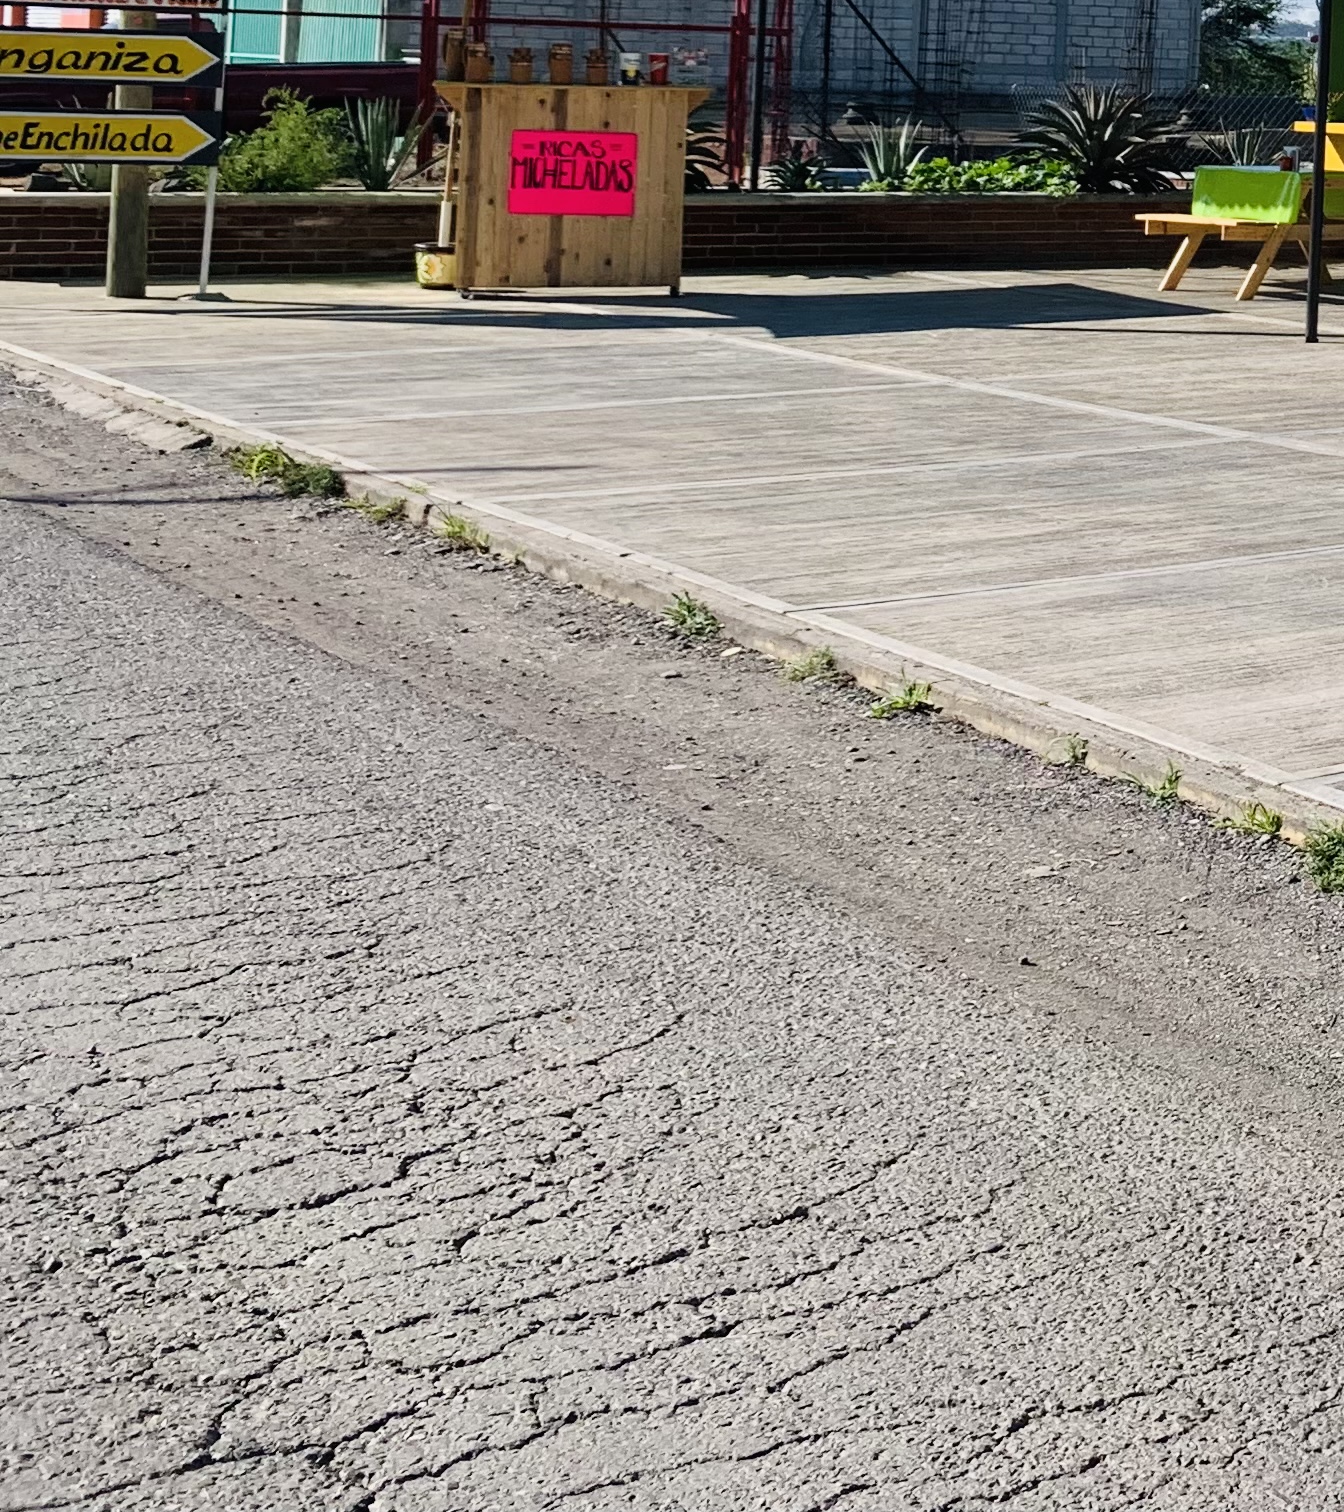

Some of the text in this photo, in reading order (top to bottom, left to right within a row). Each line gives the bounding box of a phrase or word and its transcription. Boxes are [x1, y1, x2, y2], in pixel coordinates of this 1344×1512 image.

[0, 41, 184, 74] nganiza
[538, 139, 607, 159] RICAS
[510, 156, 634, 193] MICHELADAS
